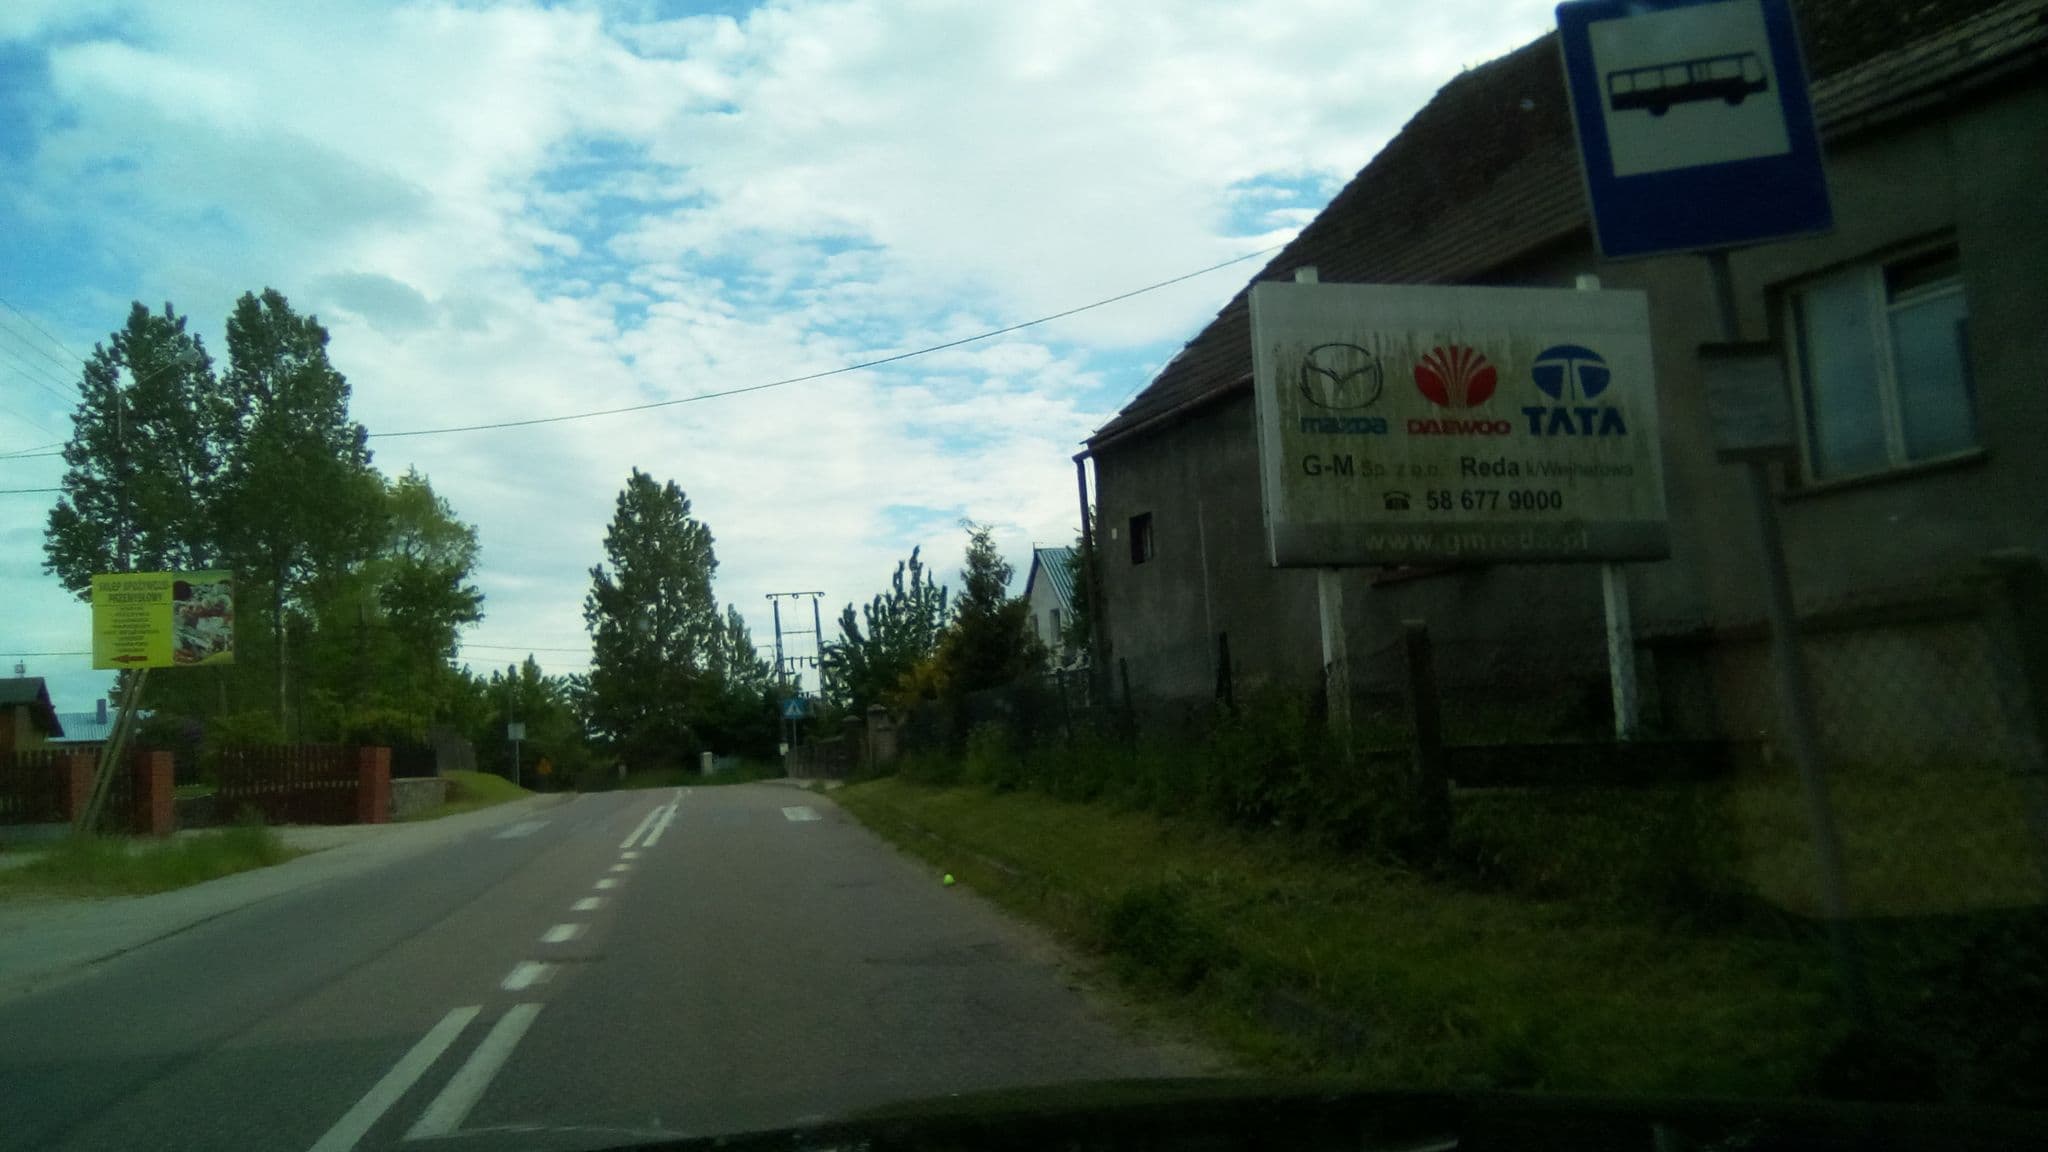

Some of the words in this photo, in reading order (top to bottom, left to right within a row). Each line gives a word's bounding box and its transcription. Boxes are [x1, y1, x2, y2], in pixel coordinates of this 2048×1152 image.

[1408, 419, 1512, 435] DAEWOO
[1521, 406, 1627, 436] TATA
[1302, 455, 1354, 477] G-M
[1460, 455, 1520, 478] Reda
[1426, 489, 1453, 511] 58
[1460, 489, 1500, 511] 677
[1507, 489, 1563, 511] 9000
